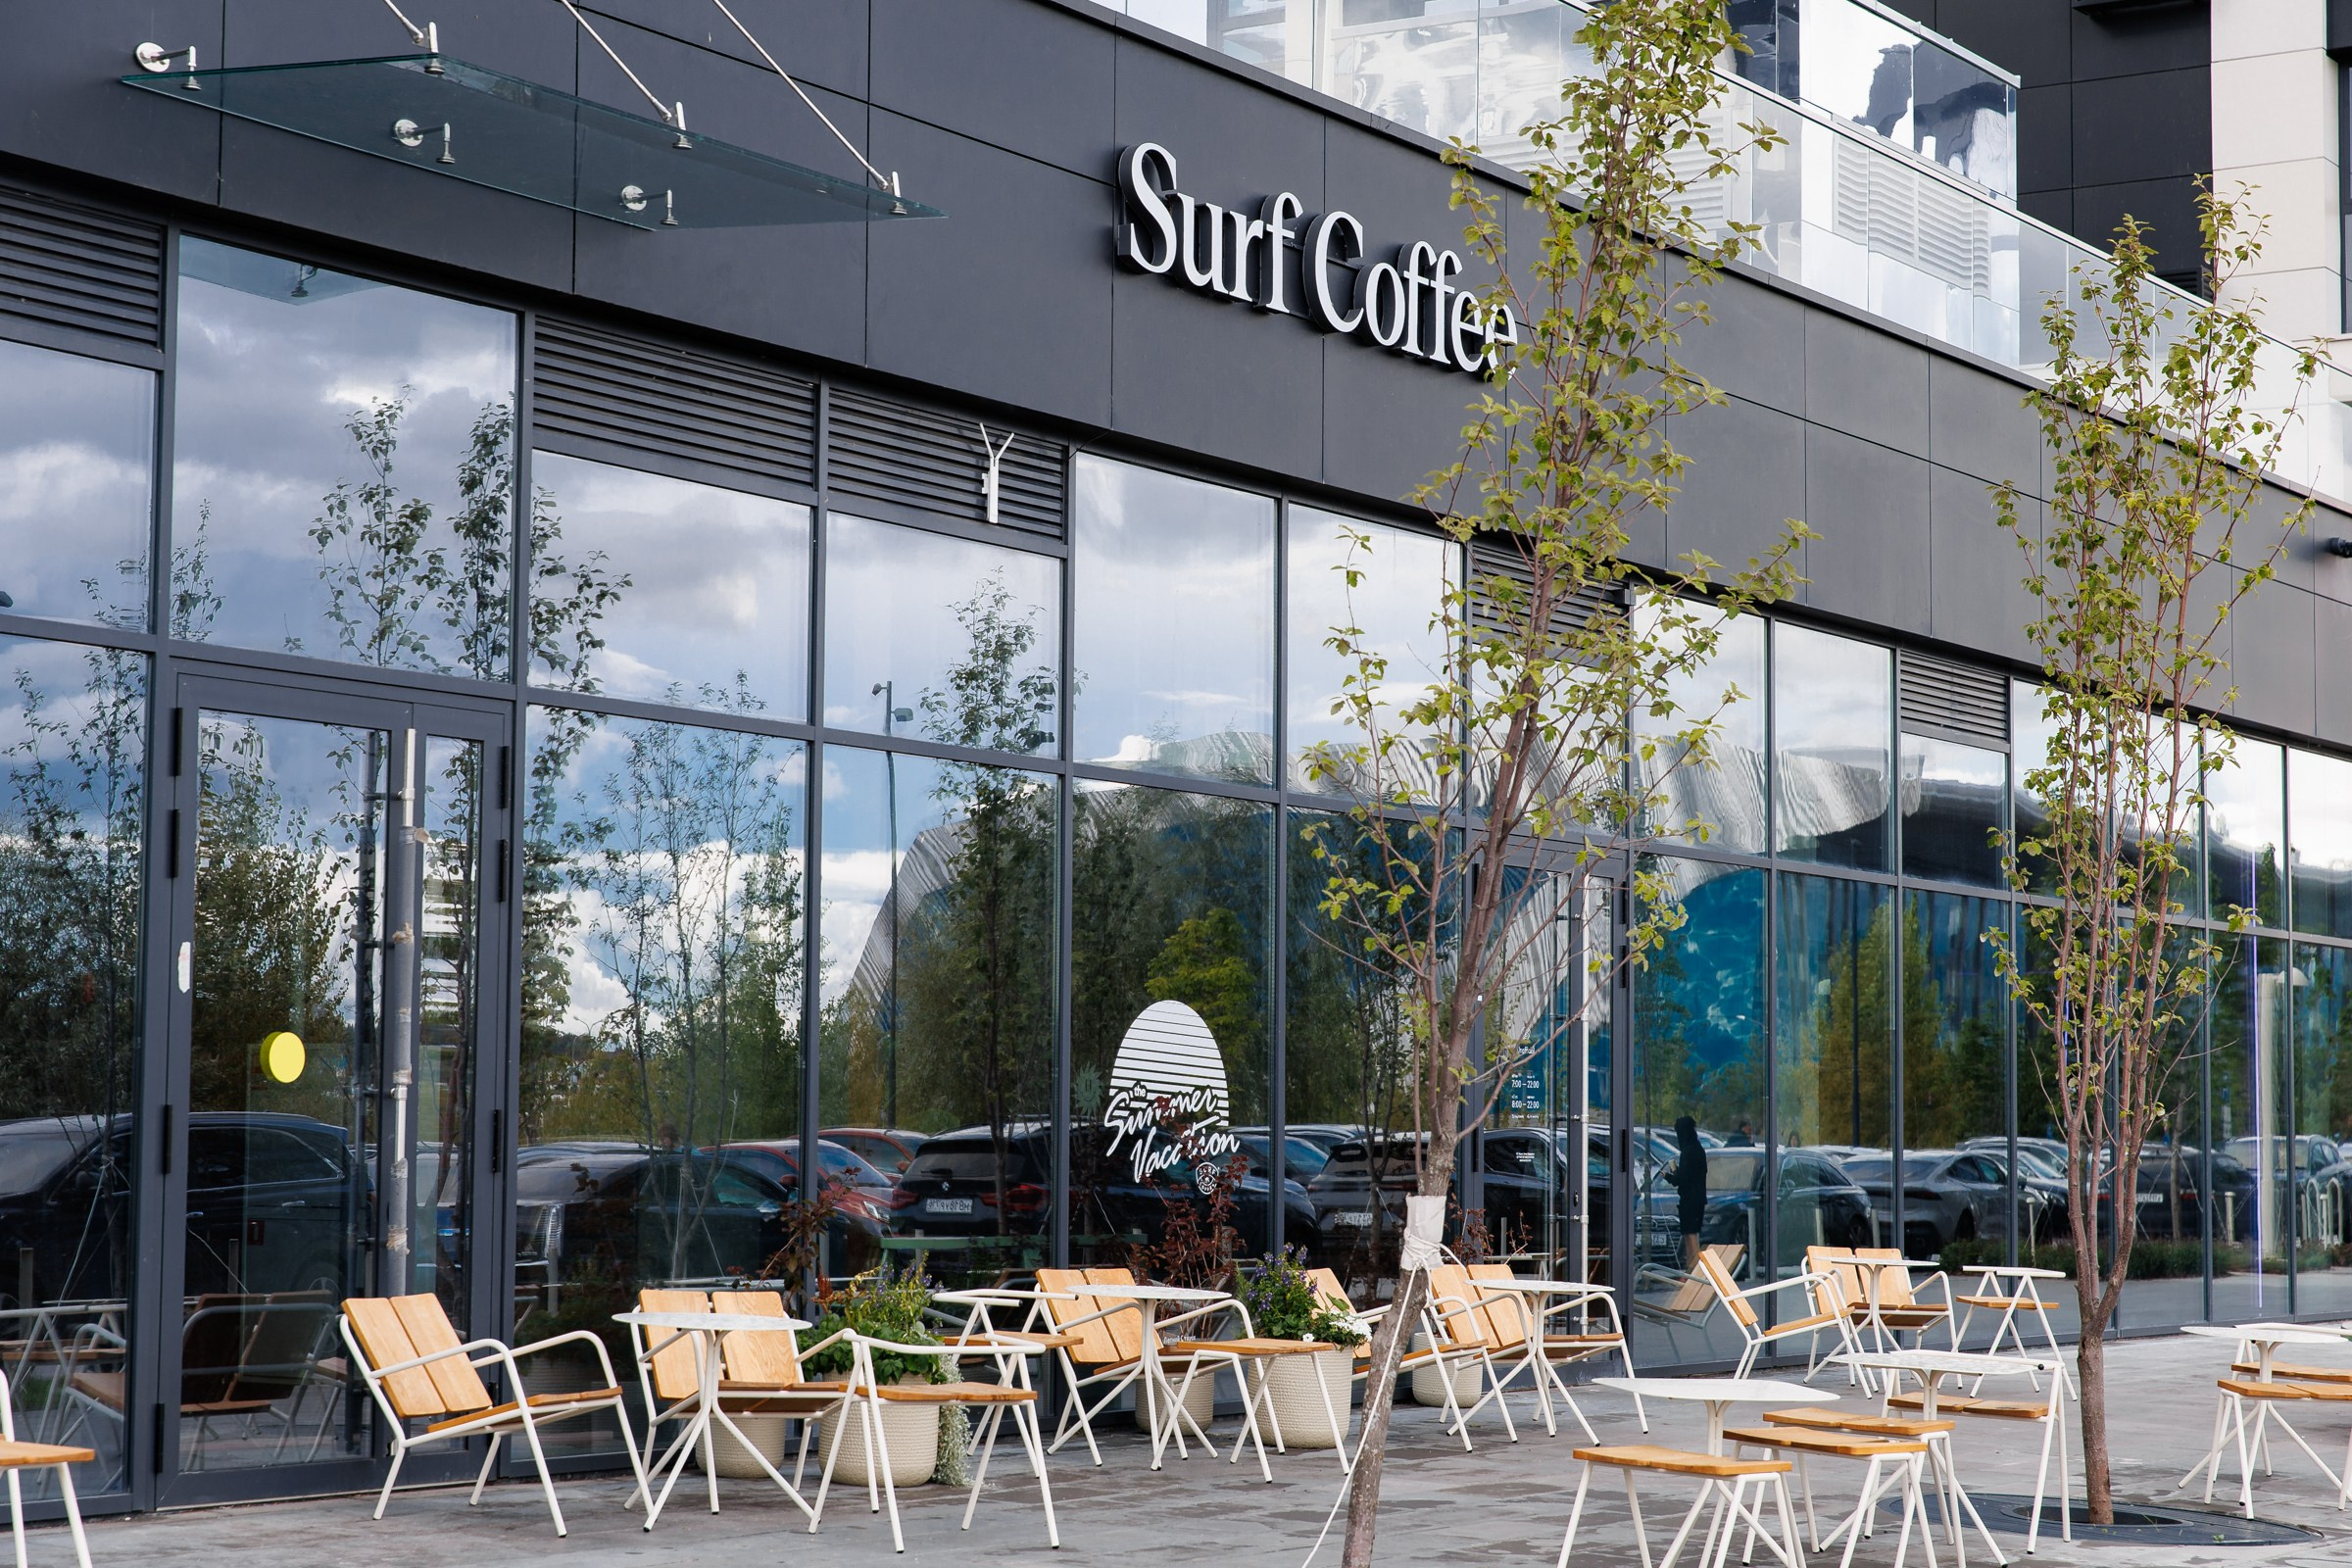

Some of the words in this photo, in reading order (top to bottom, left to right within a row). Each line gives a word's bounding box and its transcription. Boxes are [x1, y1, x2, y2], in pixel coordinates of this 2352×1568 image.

[1127, 141, 1304, 314] Surf
[1313, 210, 1518, 381] Coffee
[1511, 1079, 1522, 1088] 7:00
[1133, 1087, 1147, 1098] the
[1511, 1100, 1523, 1108] 8:00
[1527, 1101, 1540, 1109] 22:00
